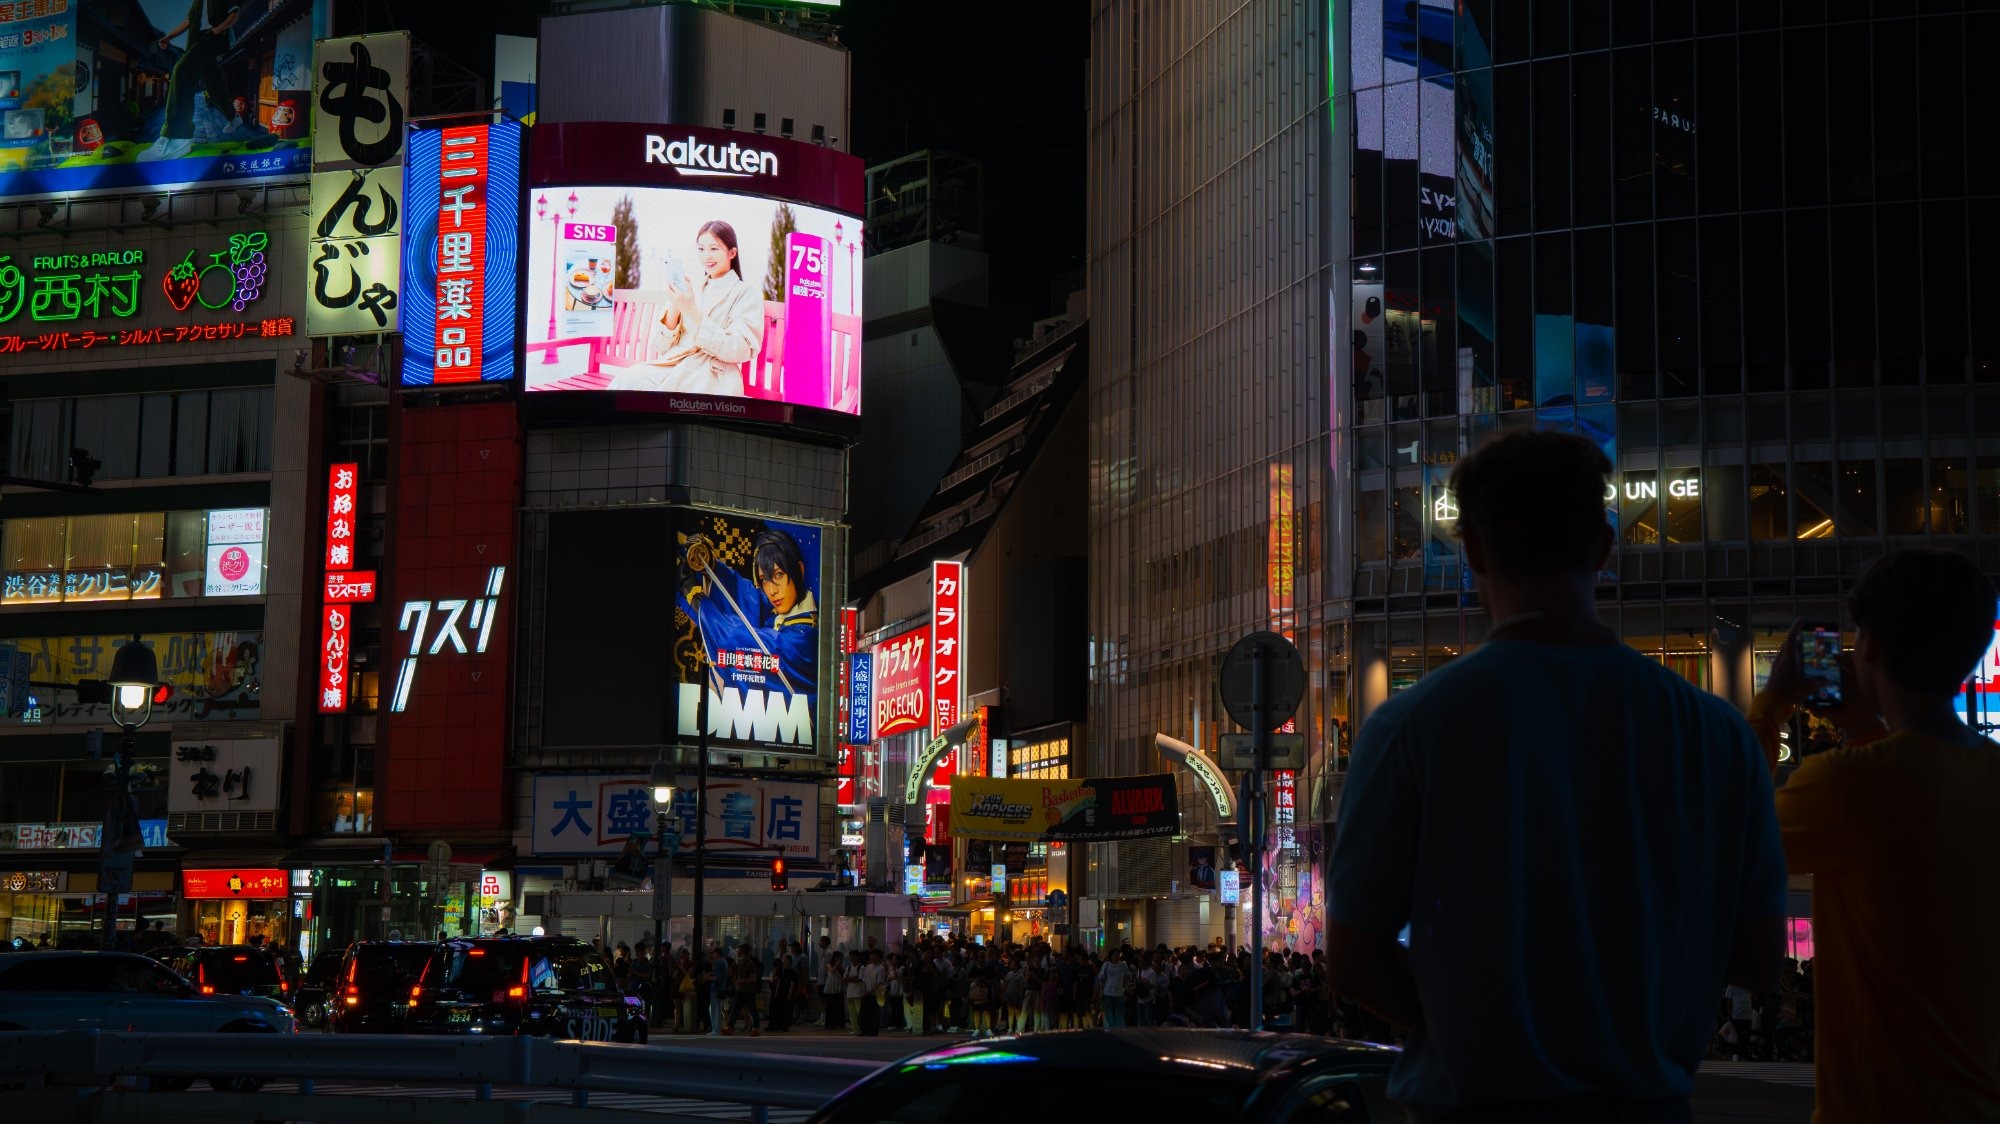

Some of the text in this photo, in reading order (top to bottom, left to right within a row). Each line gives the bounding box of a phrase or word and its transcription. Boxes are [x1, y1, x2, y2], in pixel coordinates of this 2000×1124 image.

[313, 41, 404, 328] もんじゃ
[645, 133, 778, 178] Rakuten
[435, 134, 478, 369] 三千里薬品
[573, 224, 606, 240] SNS
[31, 270, 141, 321] 西村
[669, 398, 745, 416] Rakuten Vision
[331, 468, 354, 565] お好み焼
[1602, 480, 1699, 501] OUNGE
[328, 576, 344, 584] 渋谷
[323, 609, 346, 709] もんじゃ焼
[391, 566, 506, 713] クスリ
[878, 635, 924, 680] カラオケ
[936, 577, 958, 687] カラオケ
[853, 658, 869, 741] 大盛堂商事ビル
[907, 739, 943, 803] 渋谷センター街
